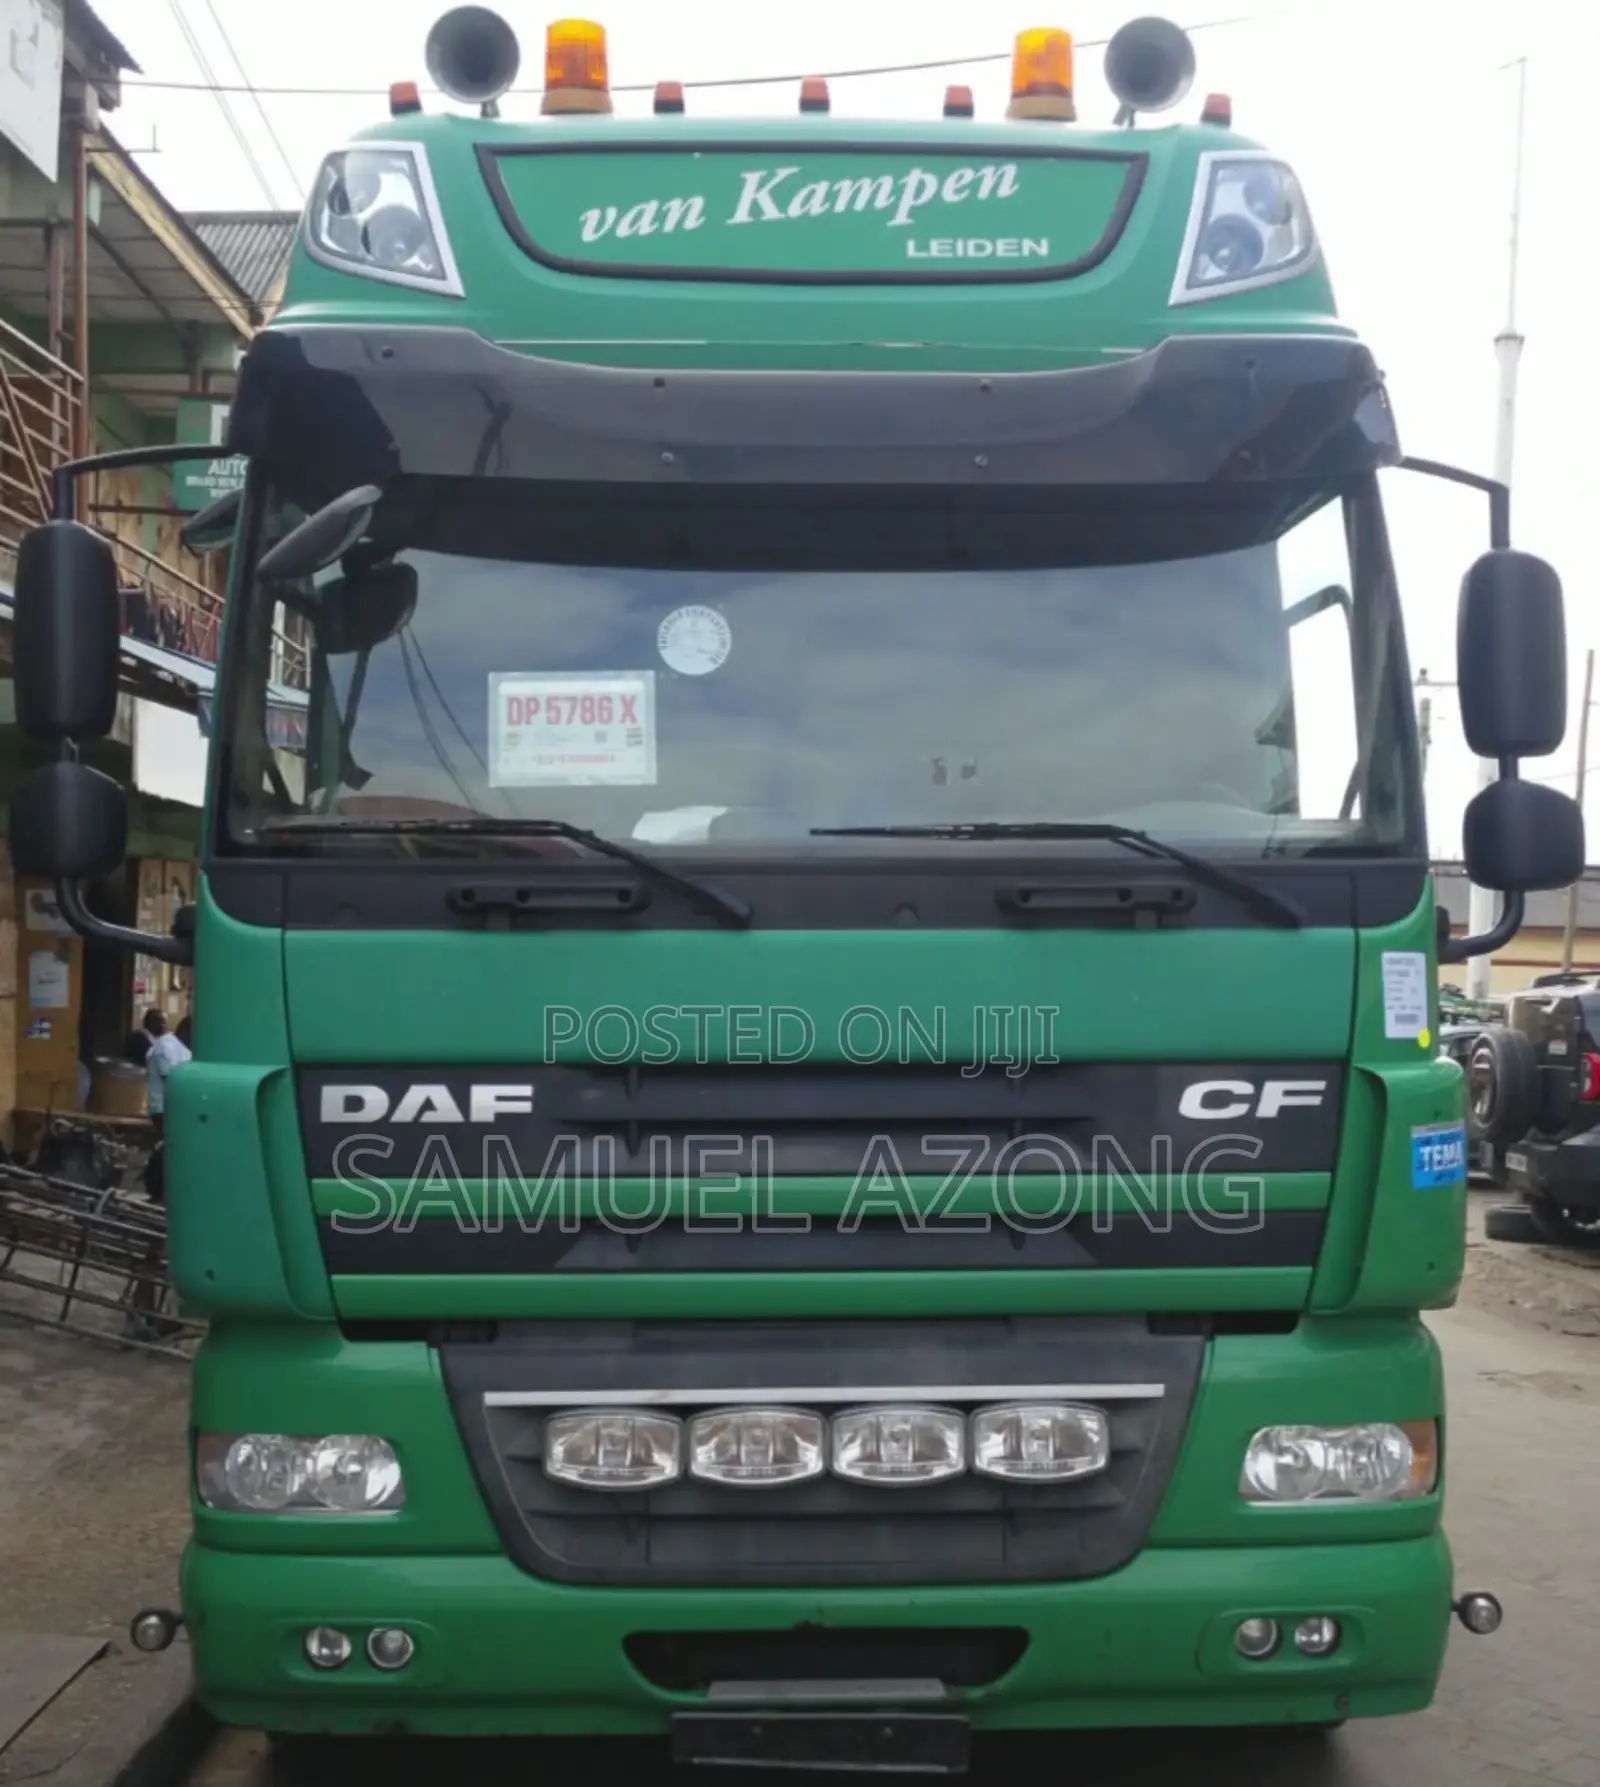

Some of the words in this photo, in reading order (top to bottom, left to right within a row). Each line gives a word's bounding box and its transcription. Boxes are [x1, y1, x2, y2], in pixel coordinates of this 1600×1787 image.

[579, 194, 706, 243] van
[726, 161, 1021, 227] Kampen
[905, 237, 1050, 259] LEIDEN
[506, 695, 541, 726] DP
[545, 695, 614, 726] 5786
[619, 694, 638, 725] X
[320, 1084, 534, 1123] DAF
[1178, 1079, 1327, 1120] CF
